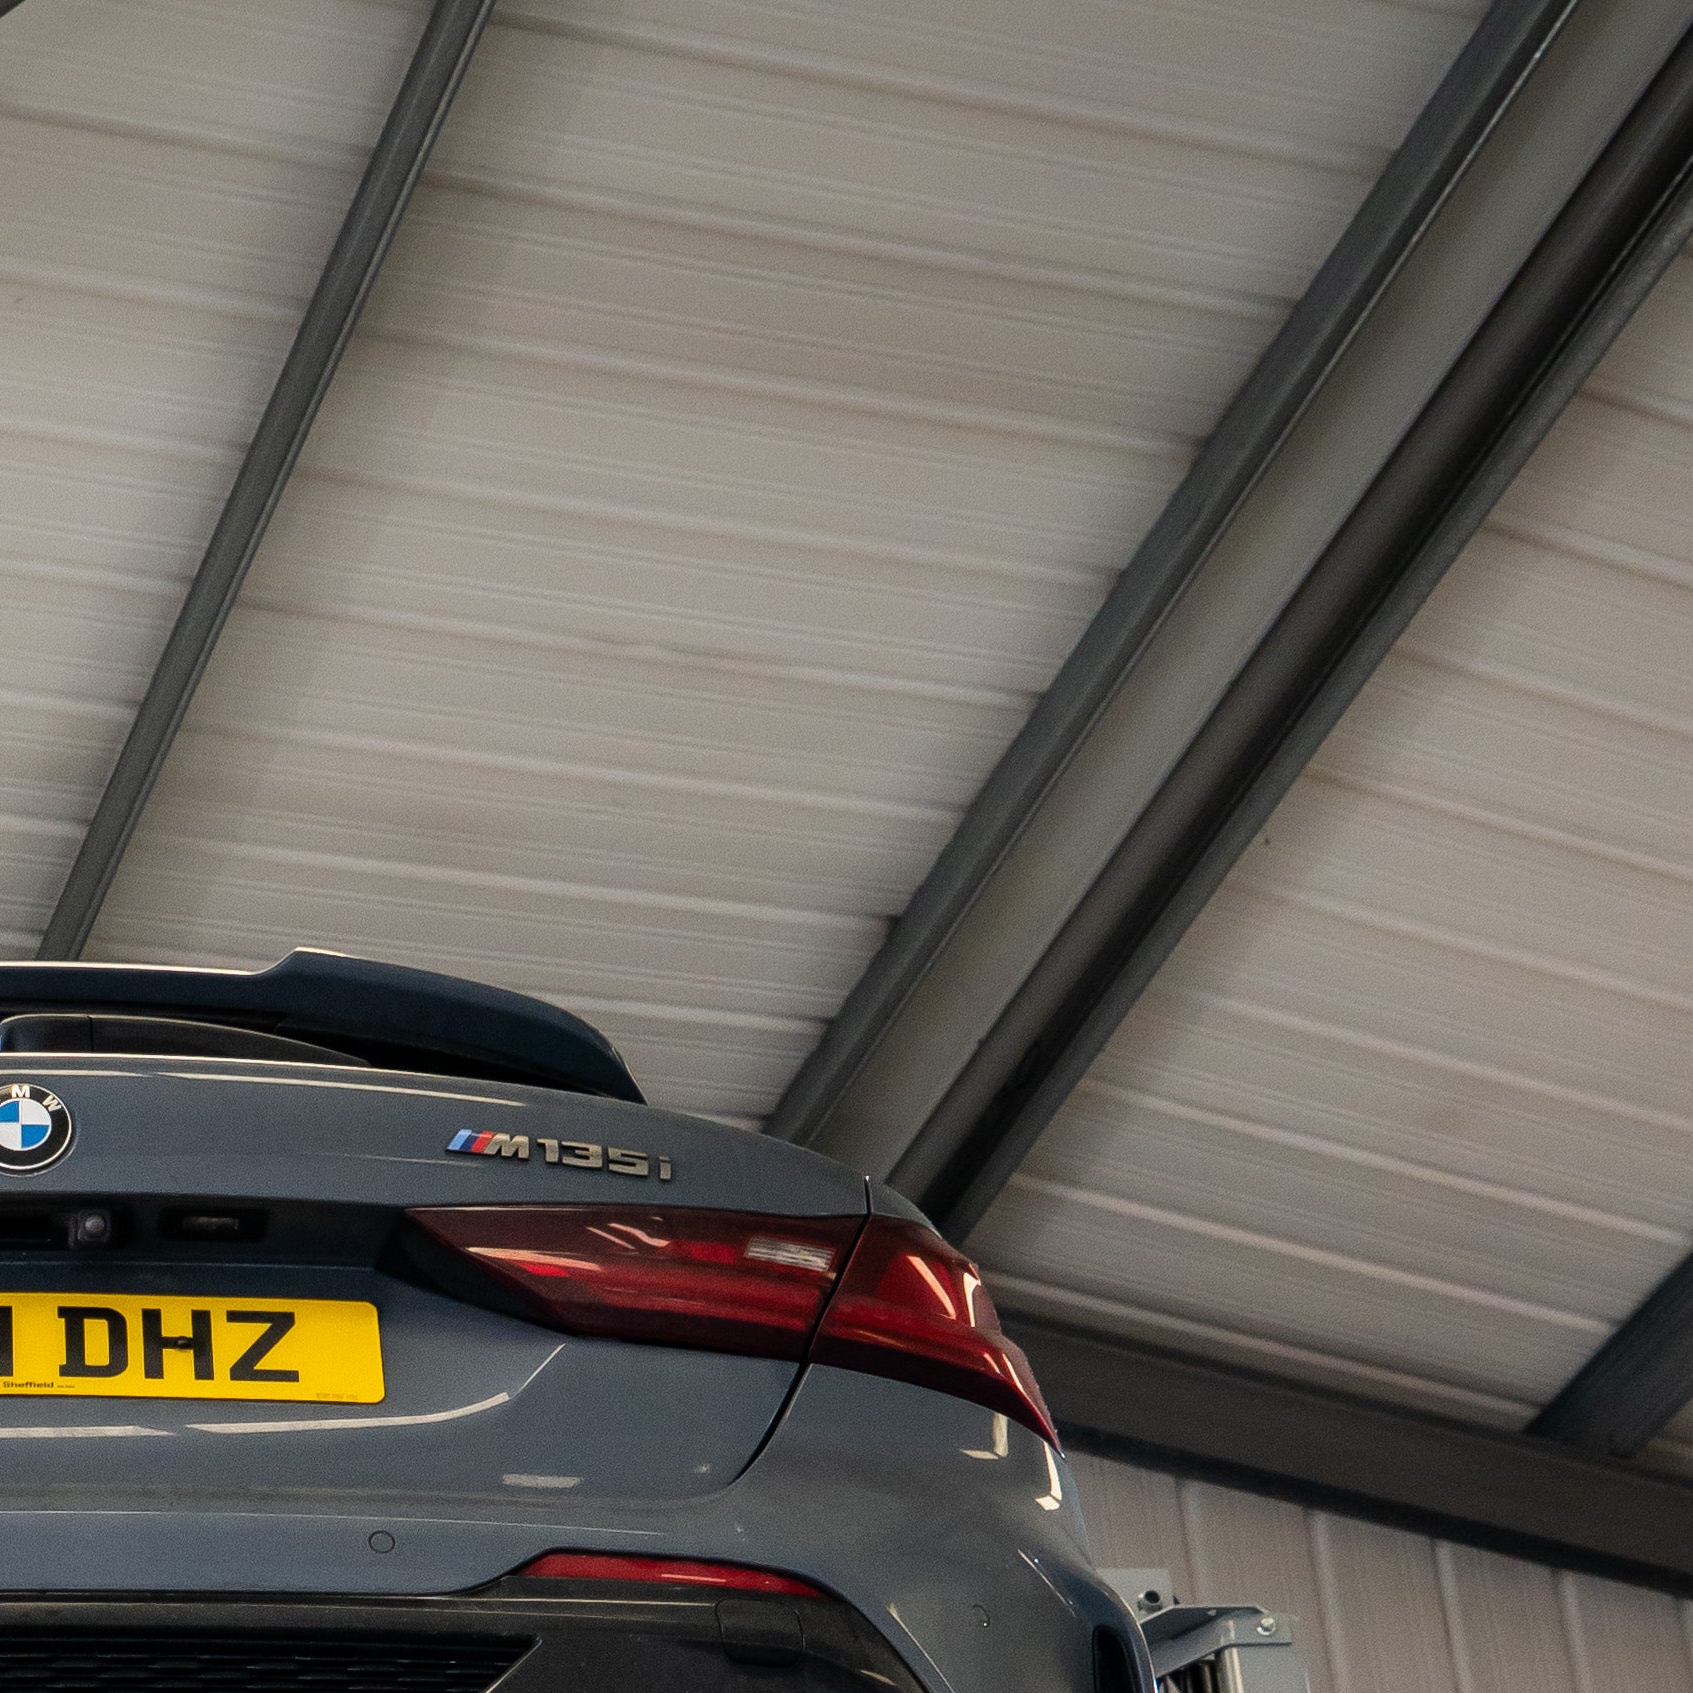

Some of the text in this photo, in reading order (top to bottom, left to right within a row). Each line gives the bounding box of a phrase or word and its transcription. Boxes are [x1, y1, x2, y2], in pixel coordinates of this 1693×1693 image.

[482, 1132, 672, 1181] M135i
[57, 1306, 300, 1382] DHZ
[3, 1381, 54, 1389] Sheffield
